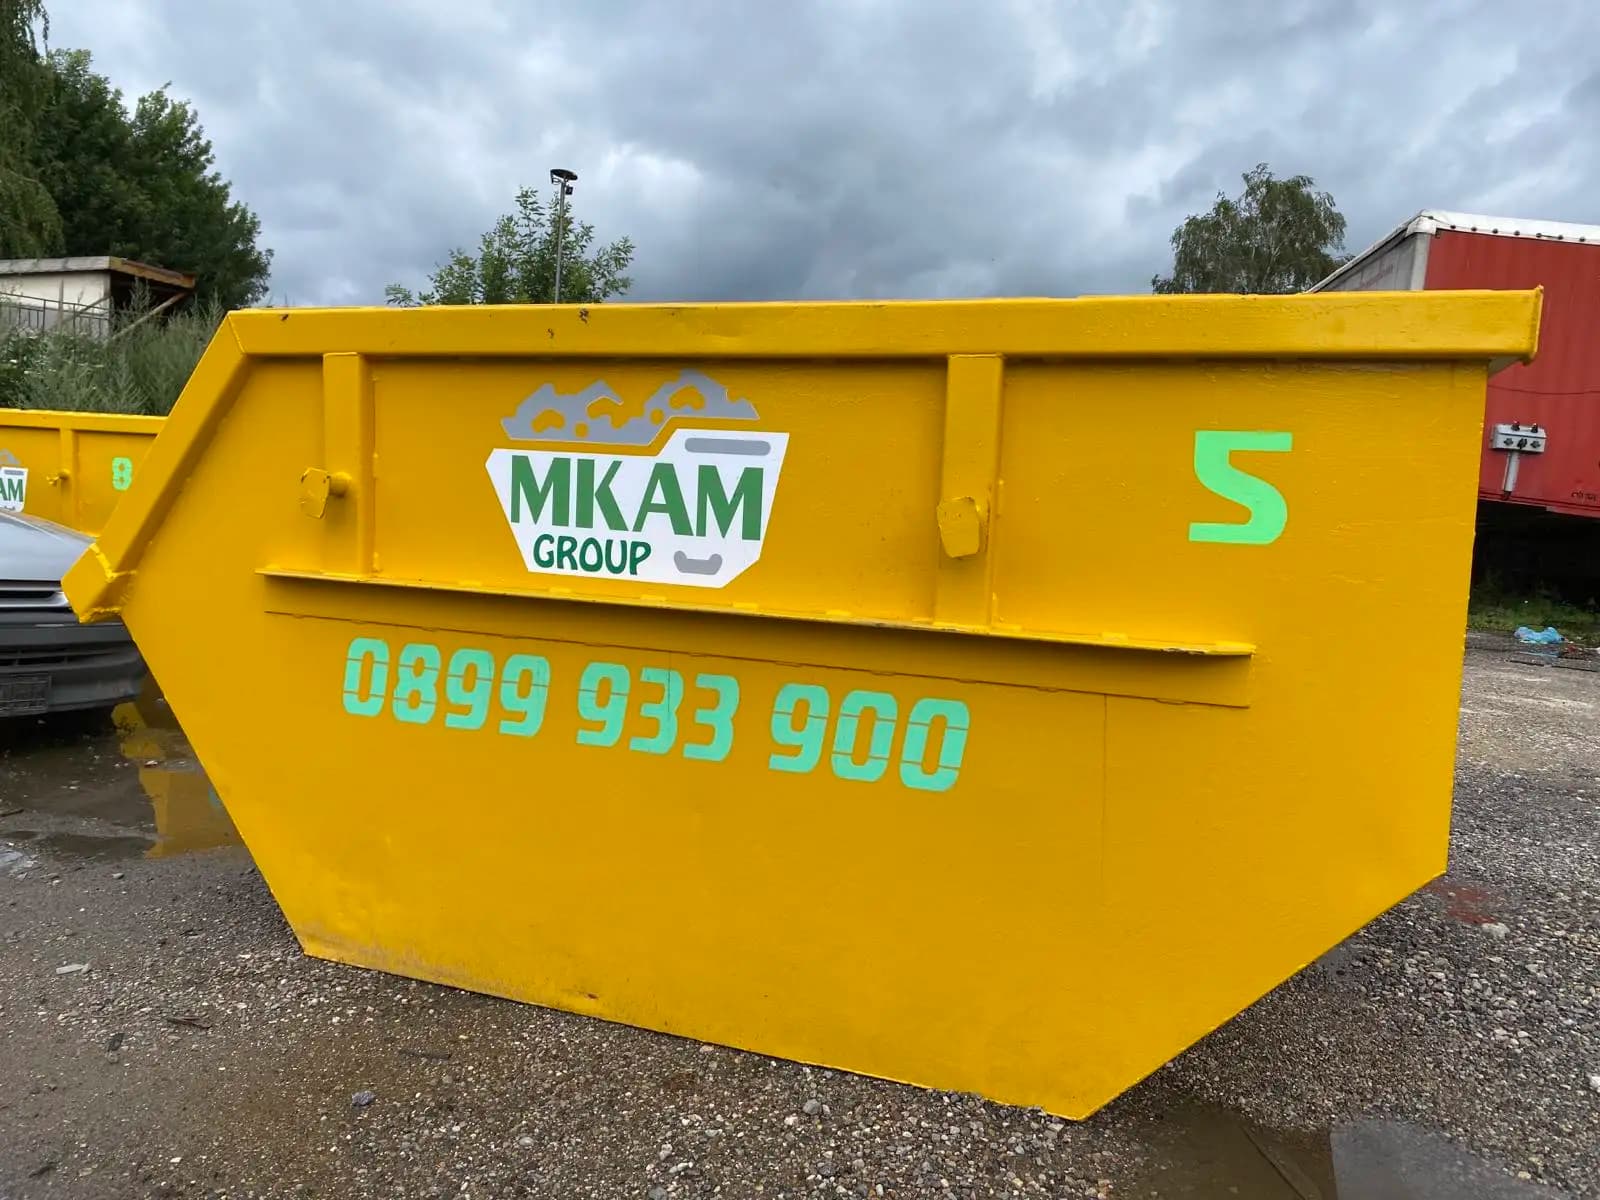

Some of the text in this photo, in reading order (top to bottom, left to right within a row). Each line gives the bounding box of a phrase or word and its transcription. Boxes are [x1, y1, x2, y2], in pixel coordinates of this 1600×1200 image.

[510, 454, 764, 541] MKAM
[532, 533, 652, 575] GROUP
[343, 637, 970, 792] 0899 933 900
